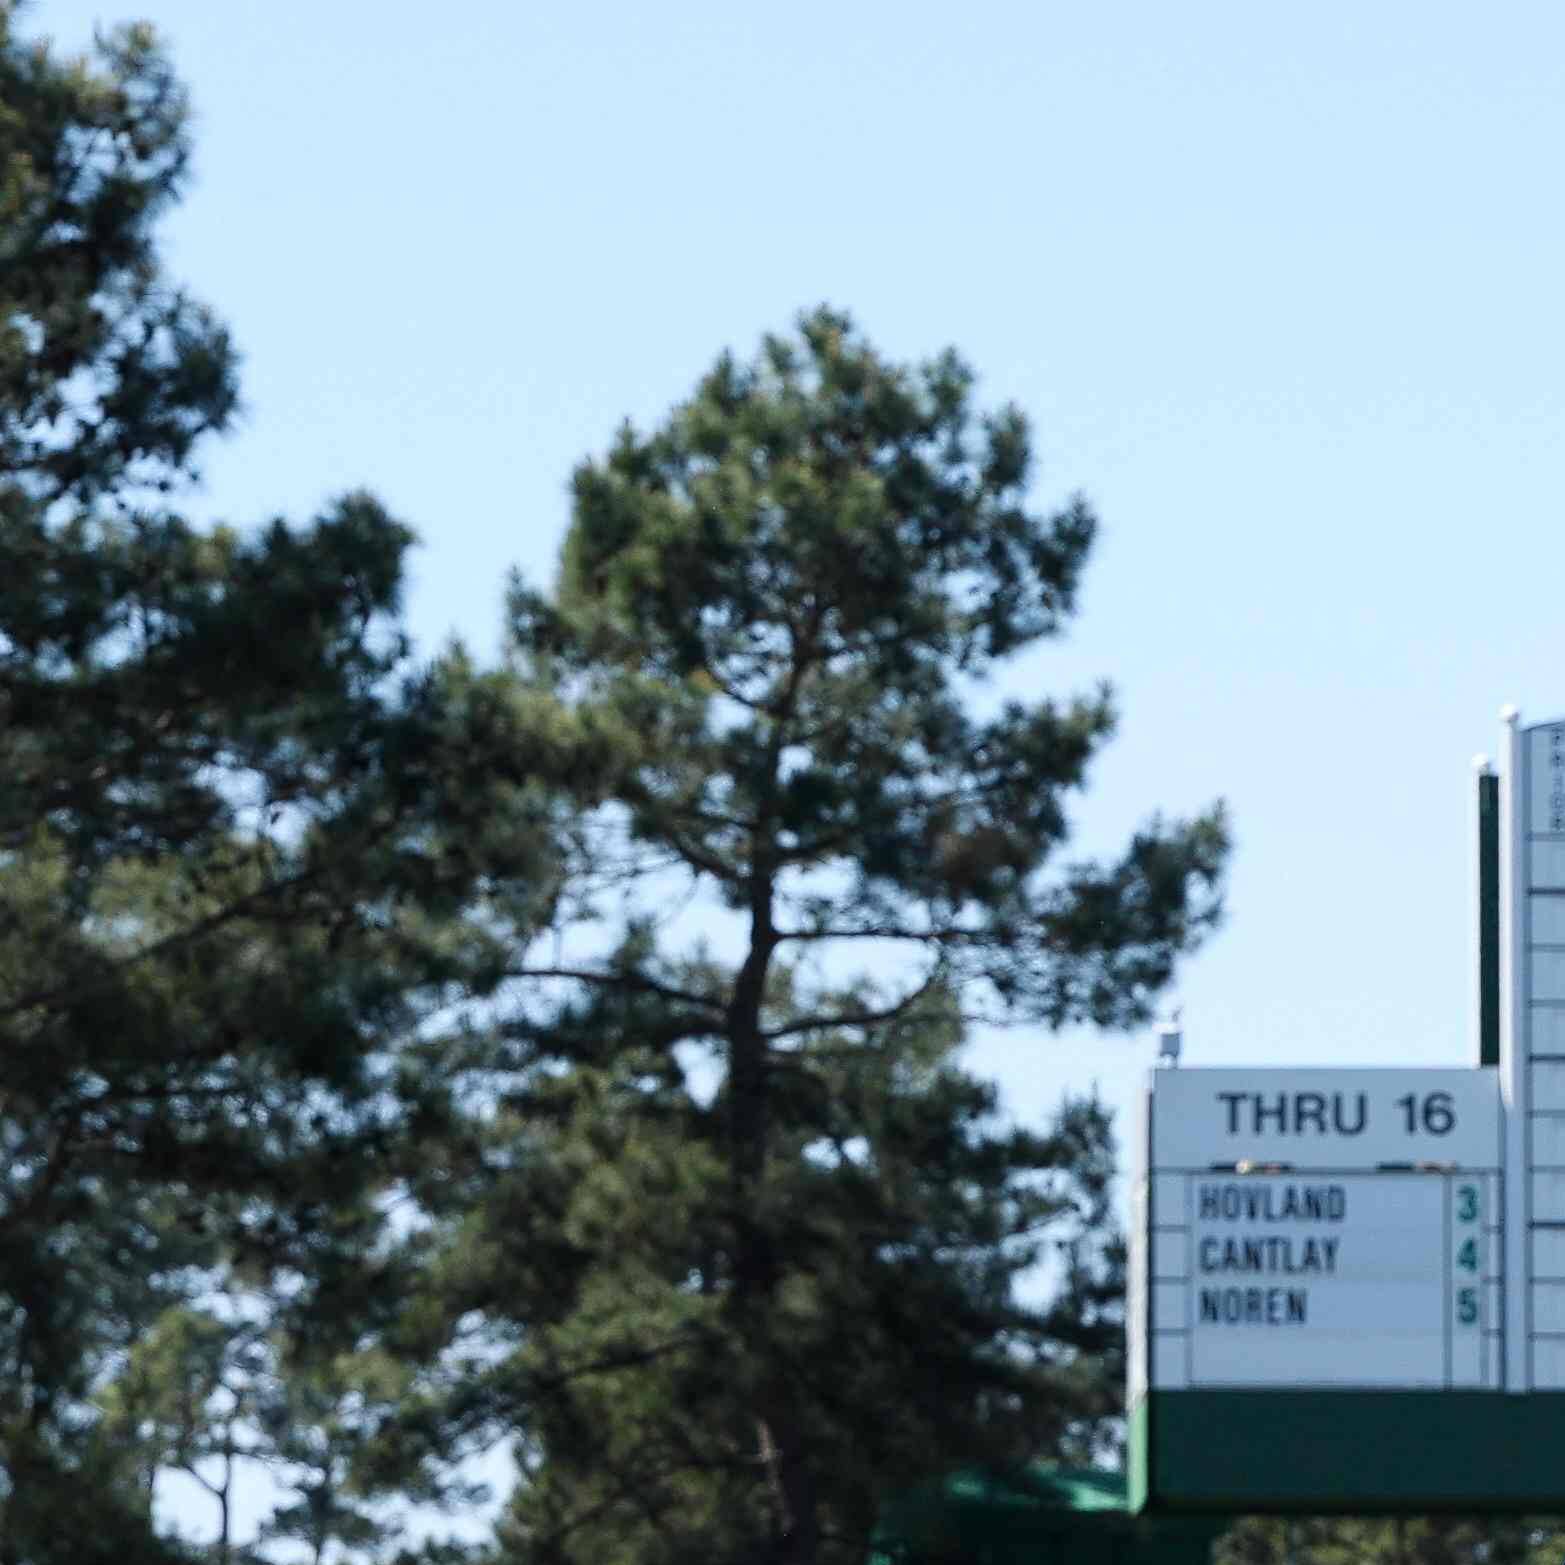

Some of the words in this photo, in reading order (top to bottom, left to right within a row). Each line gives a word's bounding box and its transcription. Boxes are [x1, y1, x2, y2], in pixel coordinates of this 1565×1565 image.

[1216, 1092, 1367, 1136] THRU
[1398, 1092, 1456, 1137] 16
[1200, 1185, 1345, 1222] HOVLAND
[1200, 1237, 1337, 1274] CANTLAY
[1458, 1238, 1480, 1273] 4
[1201, 1288, 1307, 1325] NOREN
